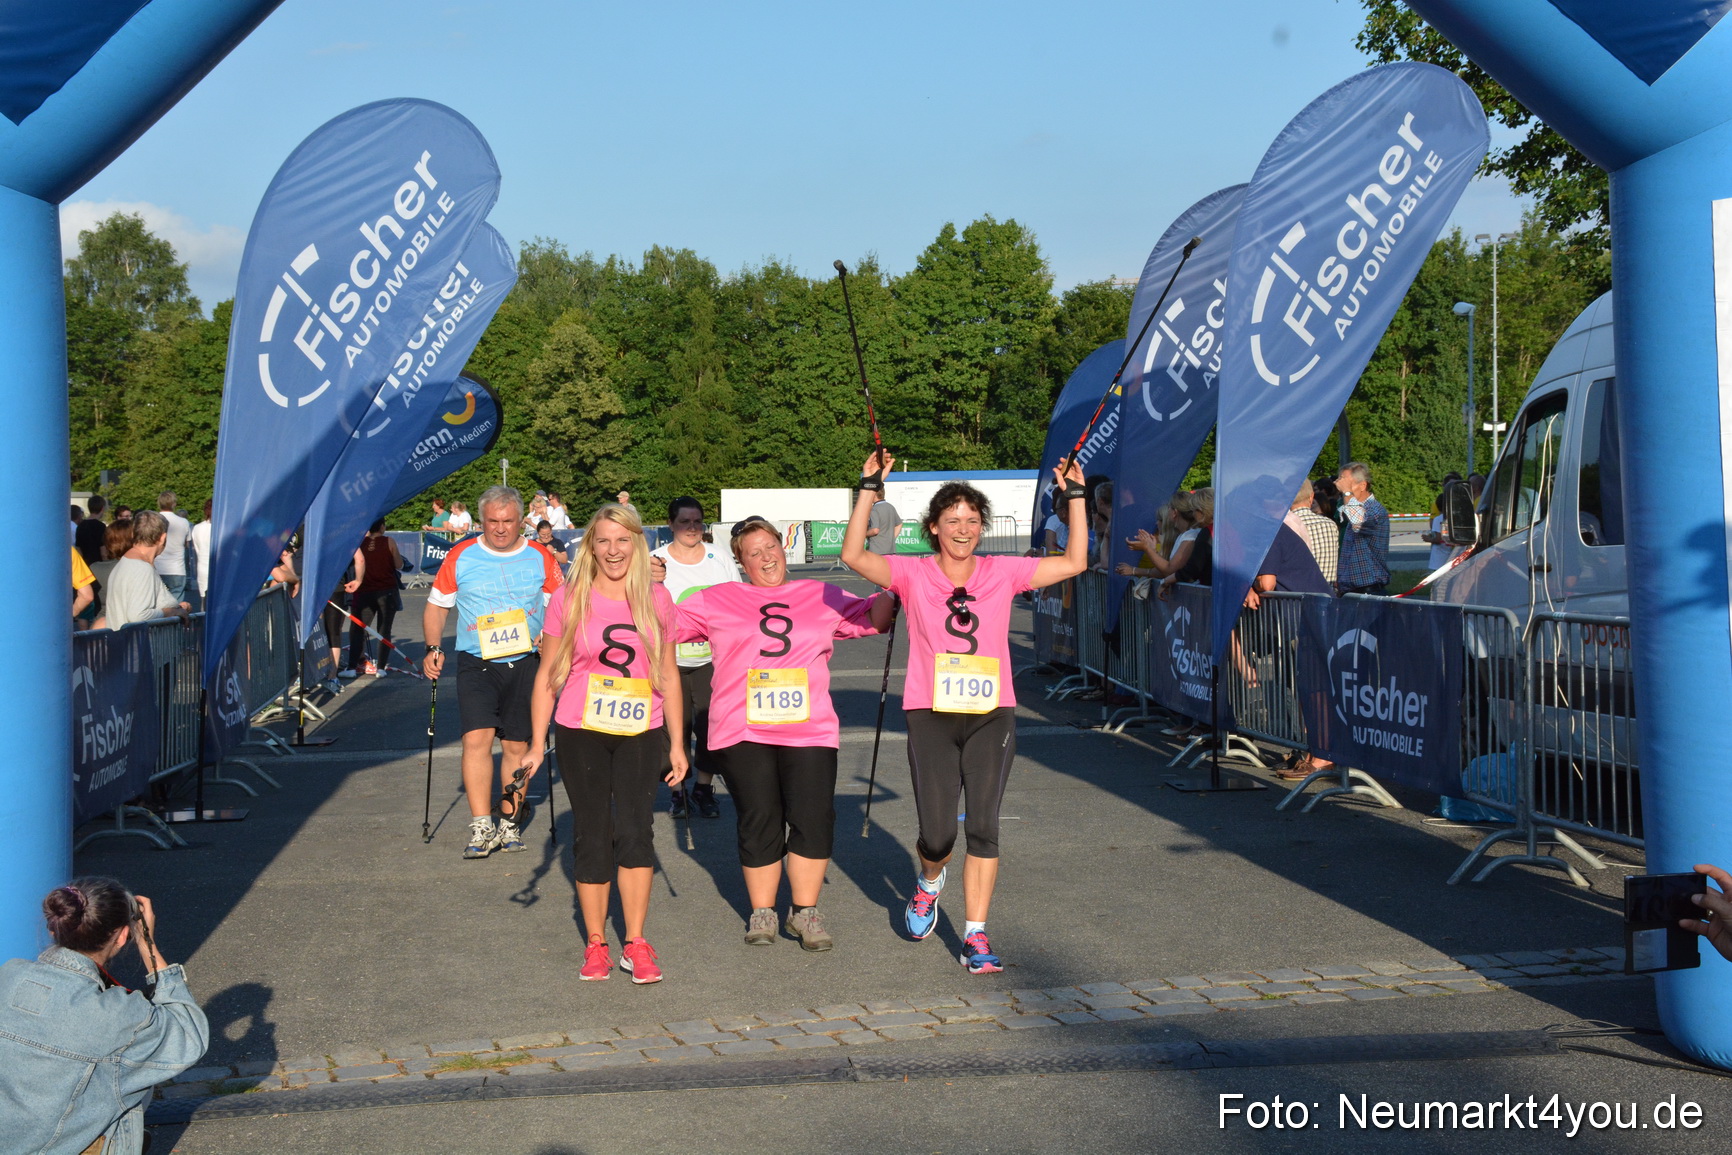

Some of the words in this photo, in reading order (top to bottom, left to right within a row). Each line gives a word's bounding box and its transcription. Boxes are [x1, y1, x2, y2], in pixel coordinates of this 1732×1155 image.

[1282, 111, 1424, 347] Fischer
[1334, 150, 1443, 341] AUTOMOBILE
[293, 150, 439, 372] Fischer
[344, 191, 455, 368] AUTOMOBILE
[402, 277, 484, 408] AUTOMOBILE
[413, 451, 441, 472] Druck
[459, 419, 493, 446] Medien
[818, 526, 845, 543] AOK
[489, 627, 520, 645] 444
[1172, 638, 1214, 679] Fischer
[593, 697, 646, 721] 1186
[753, 690, 804, 709] 1189
[941, 676, 994, 698] 1190
[1341, 671, 1428, 728] Fischer
[81, 705, 134, 764] Fischer
[1352, 725, 1424, 757] AUTOMOBILE
